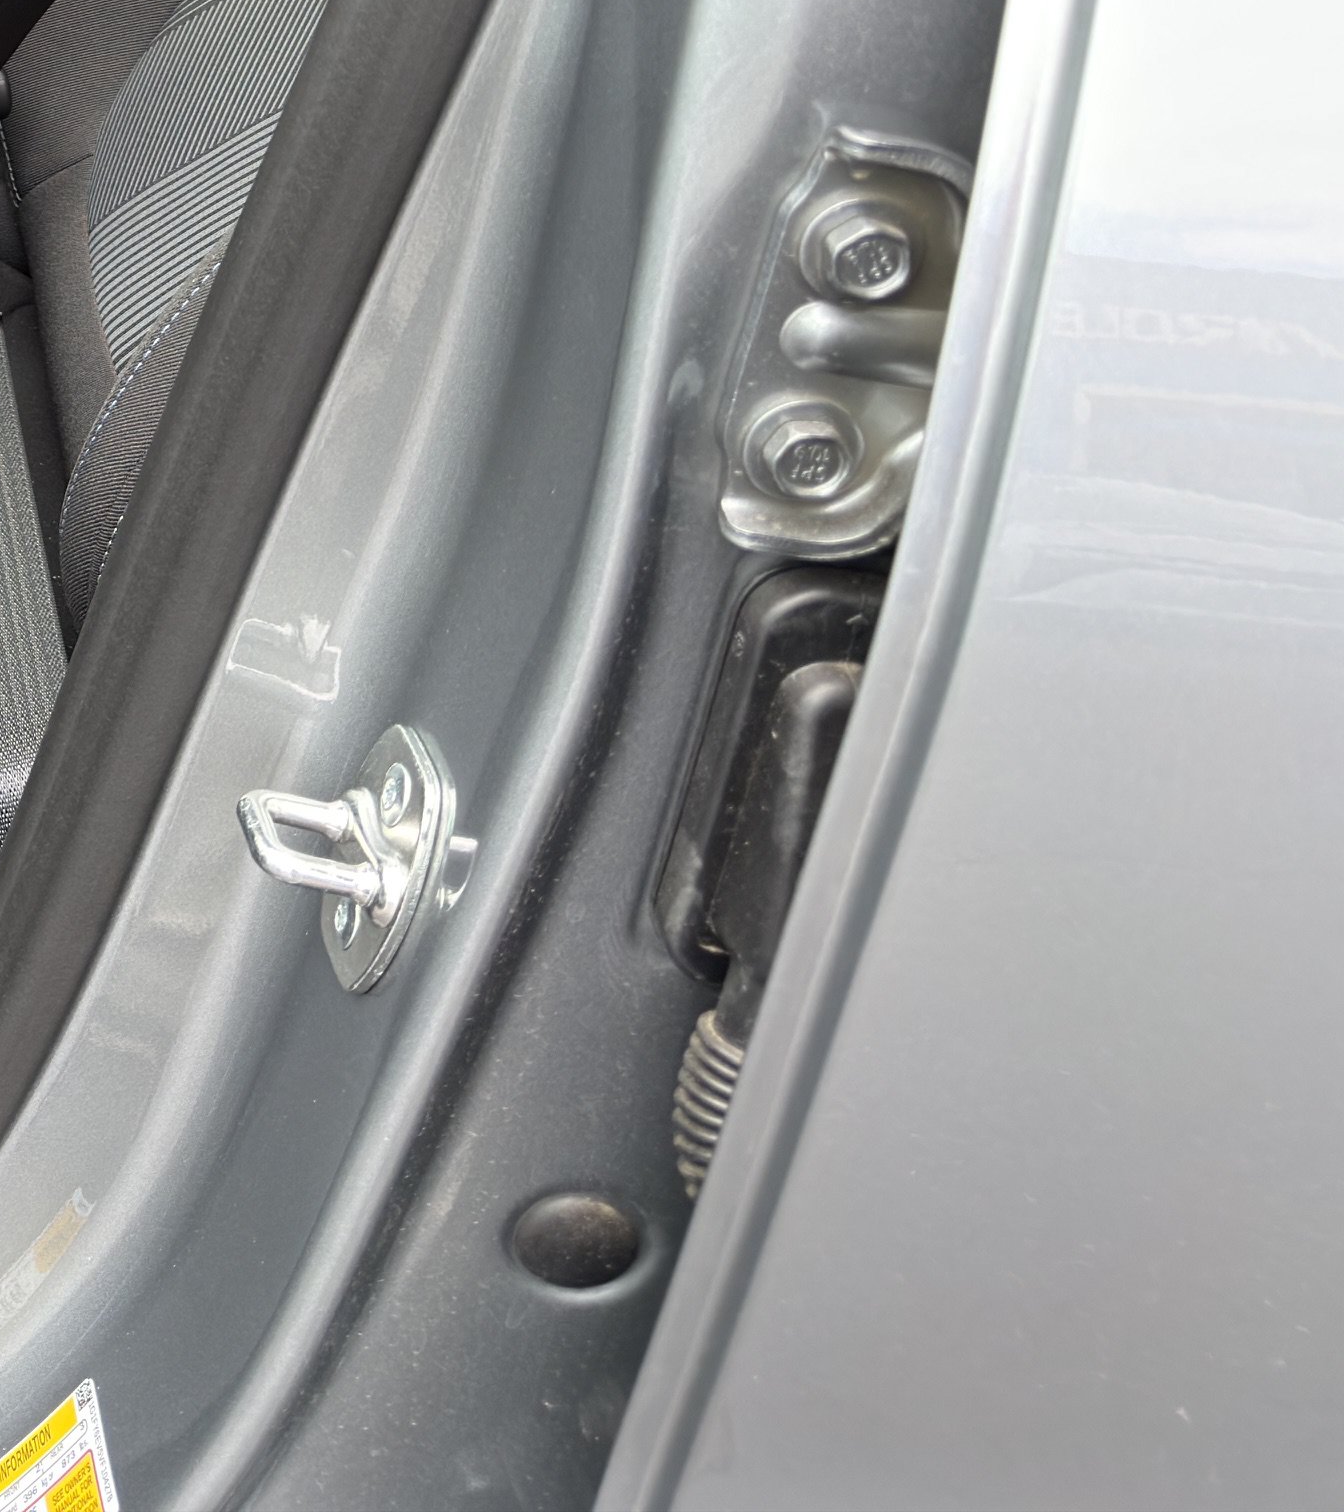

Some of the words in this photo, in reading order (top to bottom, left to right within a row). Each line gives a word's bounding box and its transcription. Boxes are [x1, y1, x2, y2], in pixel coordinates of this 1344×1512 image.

[23, 1485, 38, 1504] 396
[61, 1449, 76, 1469] 873
[80, 1475, 93, 1493] FOR
[52, 1487, 67, 1506] SEE
